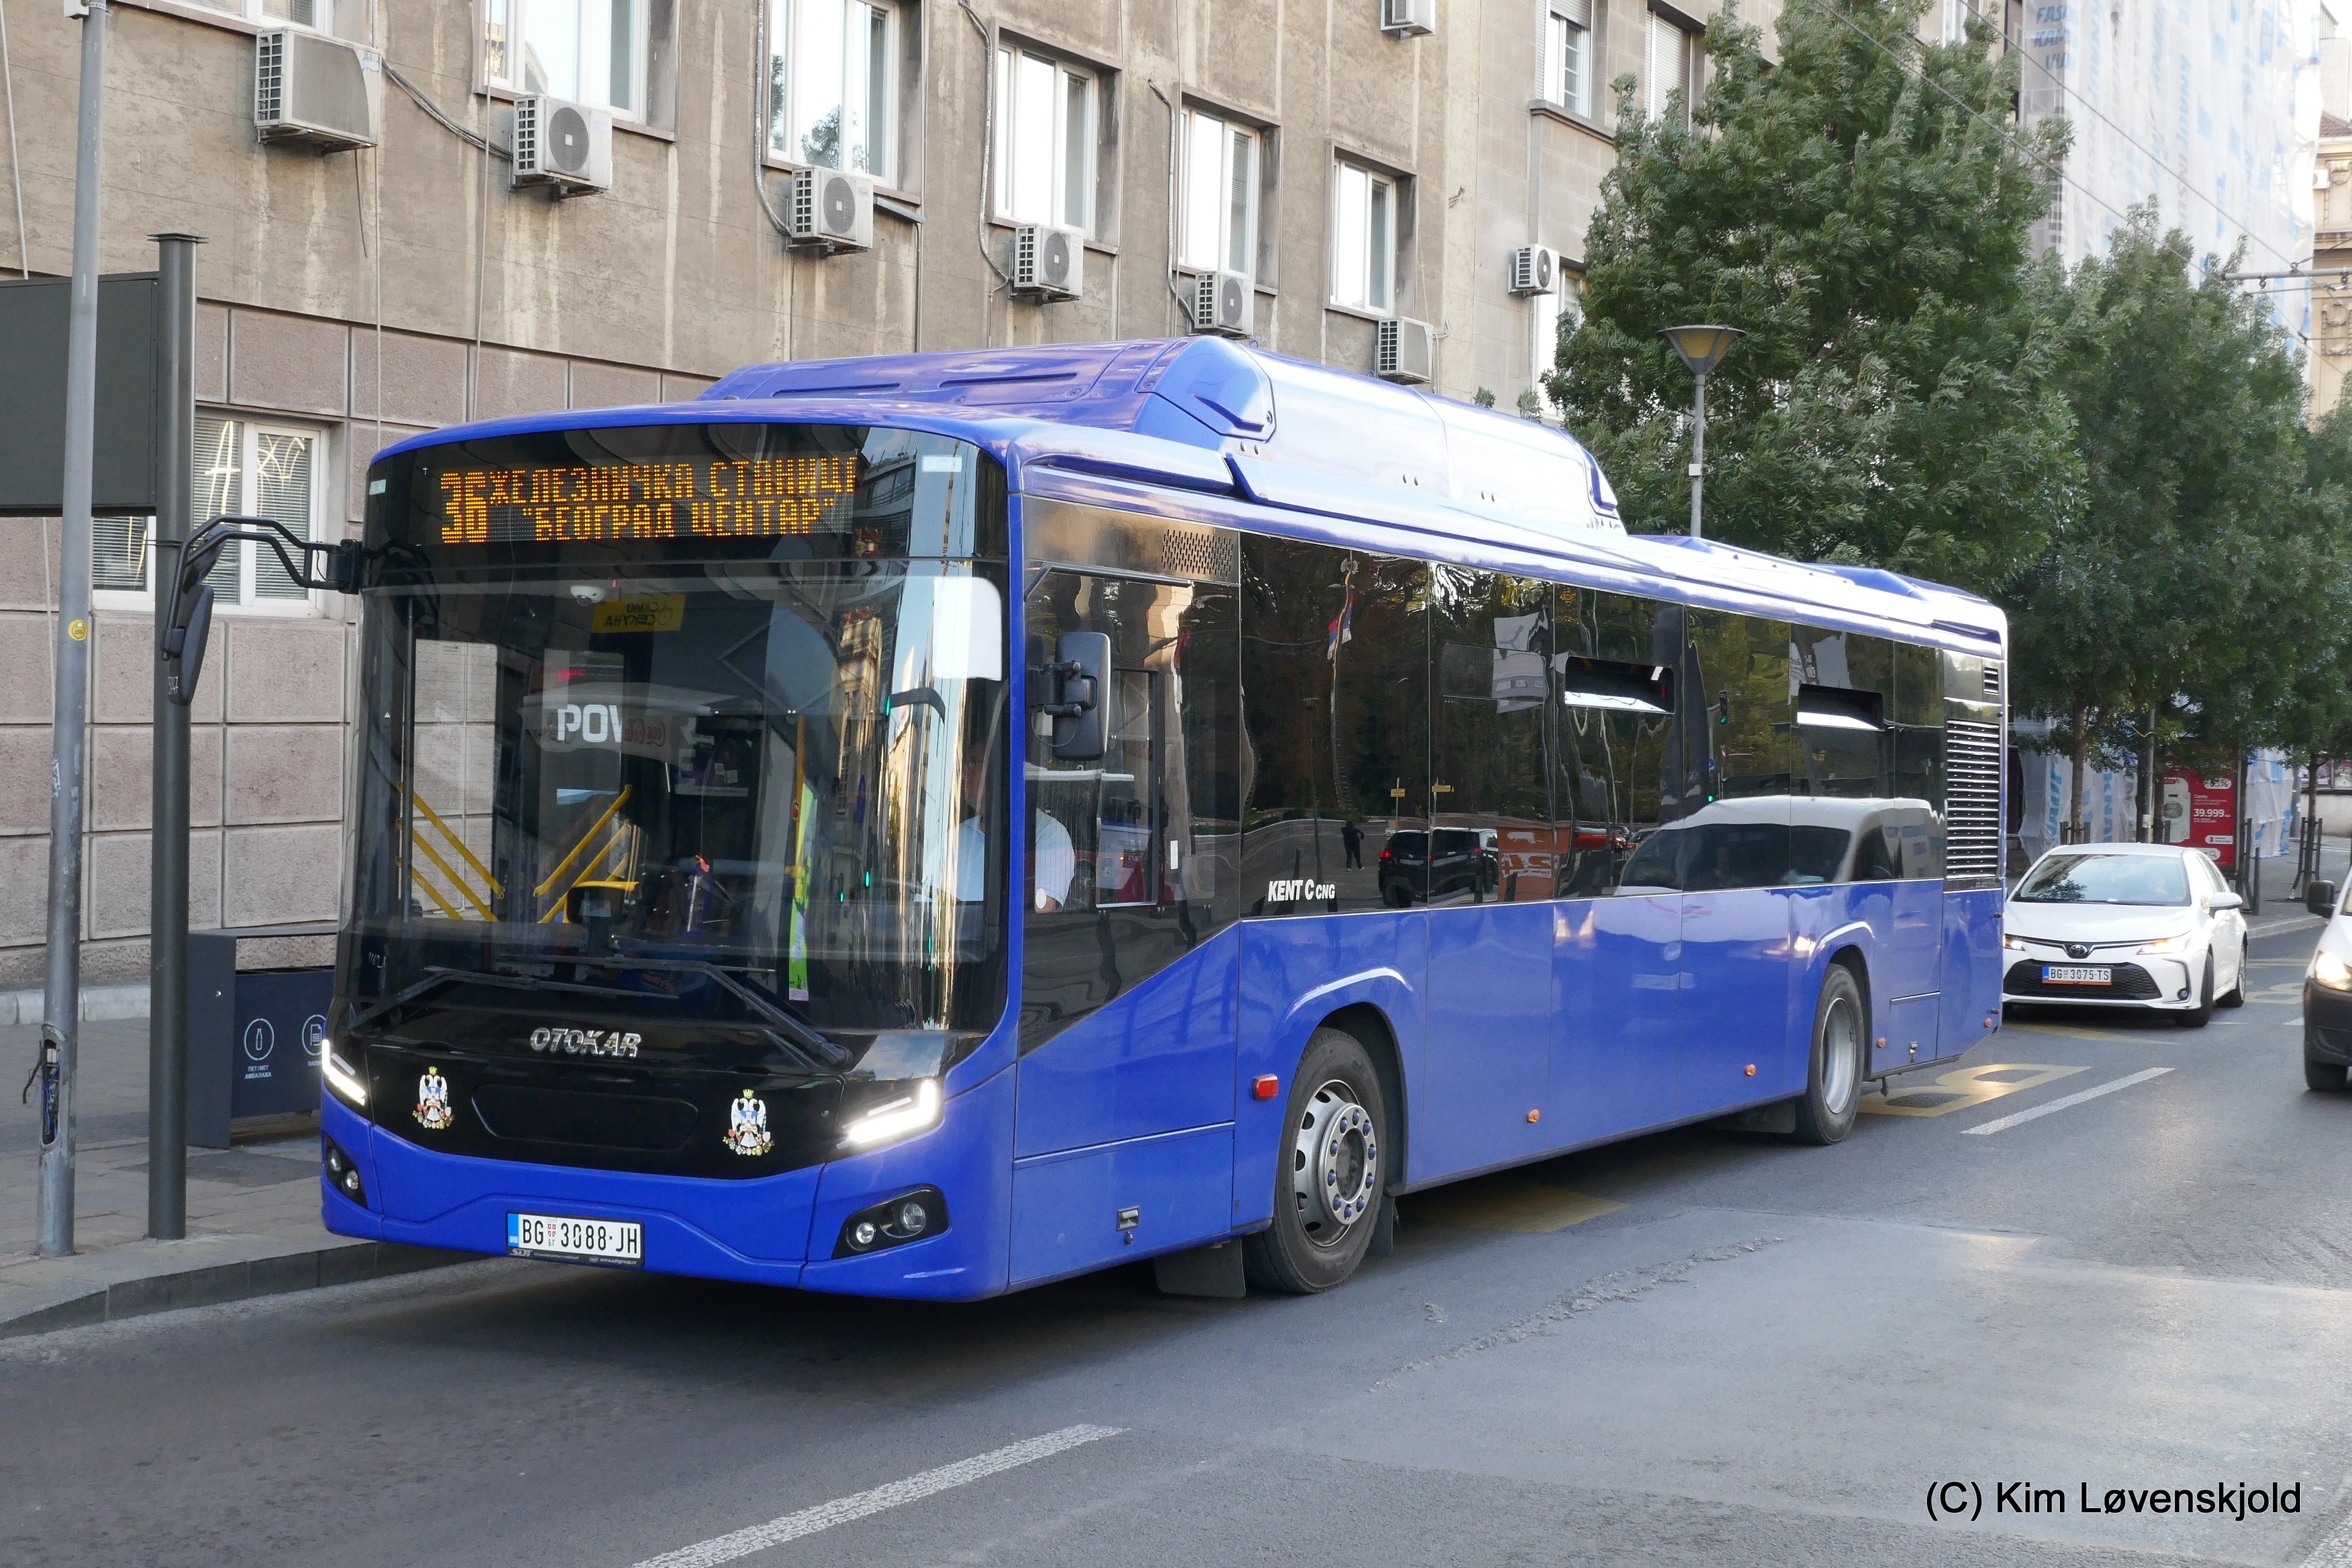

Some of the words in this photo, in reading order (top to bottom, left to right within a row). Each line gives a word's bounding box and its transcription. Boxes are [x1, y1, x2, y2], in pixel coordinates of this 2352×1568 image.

[489, 463, 694, 505] ЖЕЛЕЗНИЧКА
[441, 472, 488, 544] 36
[2193, 809, 2225, 818] 39.999
[1268, 880, 1303, 902] KENT
[1305, 879, 1314, 900] C
[1316, 884, 1335, 900] CNG
[2051, 968, 2062, 979] BG
[530, 1027, 641, 1058] OTOKAR
[522, 1219, 544, 1245] BG
